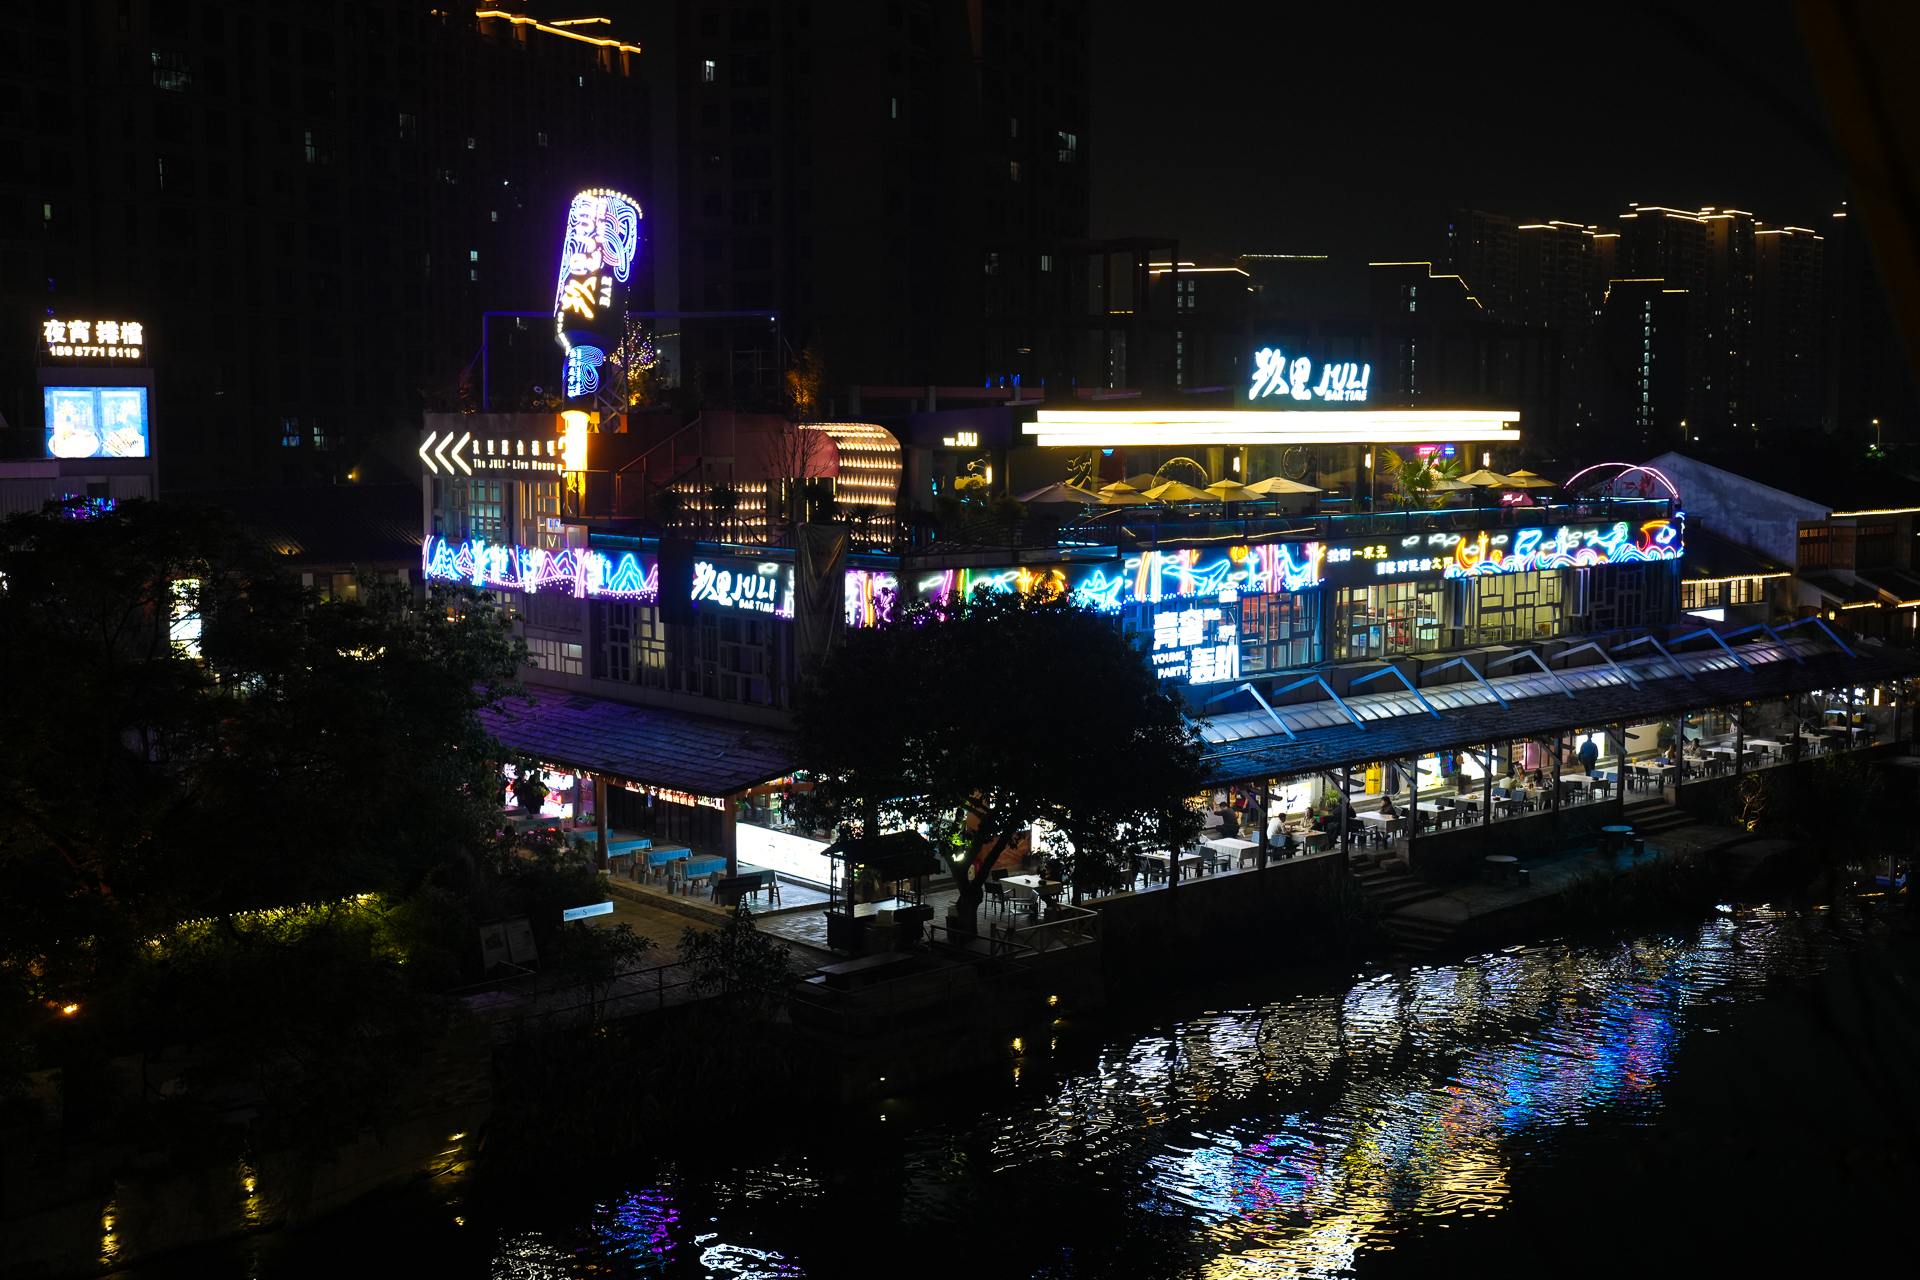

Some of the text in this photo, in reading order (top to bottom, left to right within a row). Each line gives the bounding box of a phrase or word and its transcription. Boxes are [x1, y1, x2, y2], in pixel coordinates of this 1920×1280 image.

[599, 276, 613, 308] BAR
[75, 346, 105, 357] 5771
[108, 347, 140, 358] 5119
[1313, 363, 1371, 396] JULI
[956, 432, 978, 447] JULI
[473, 459, 556, 471] The JULI Live House
[731, 573, 776, 602] JULI
[738, 598, 775, 613] BAR TIME
[1152, 651, 1186, 665] YOUNG
[1158, 665, 1188, 680] PARTY
